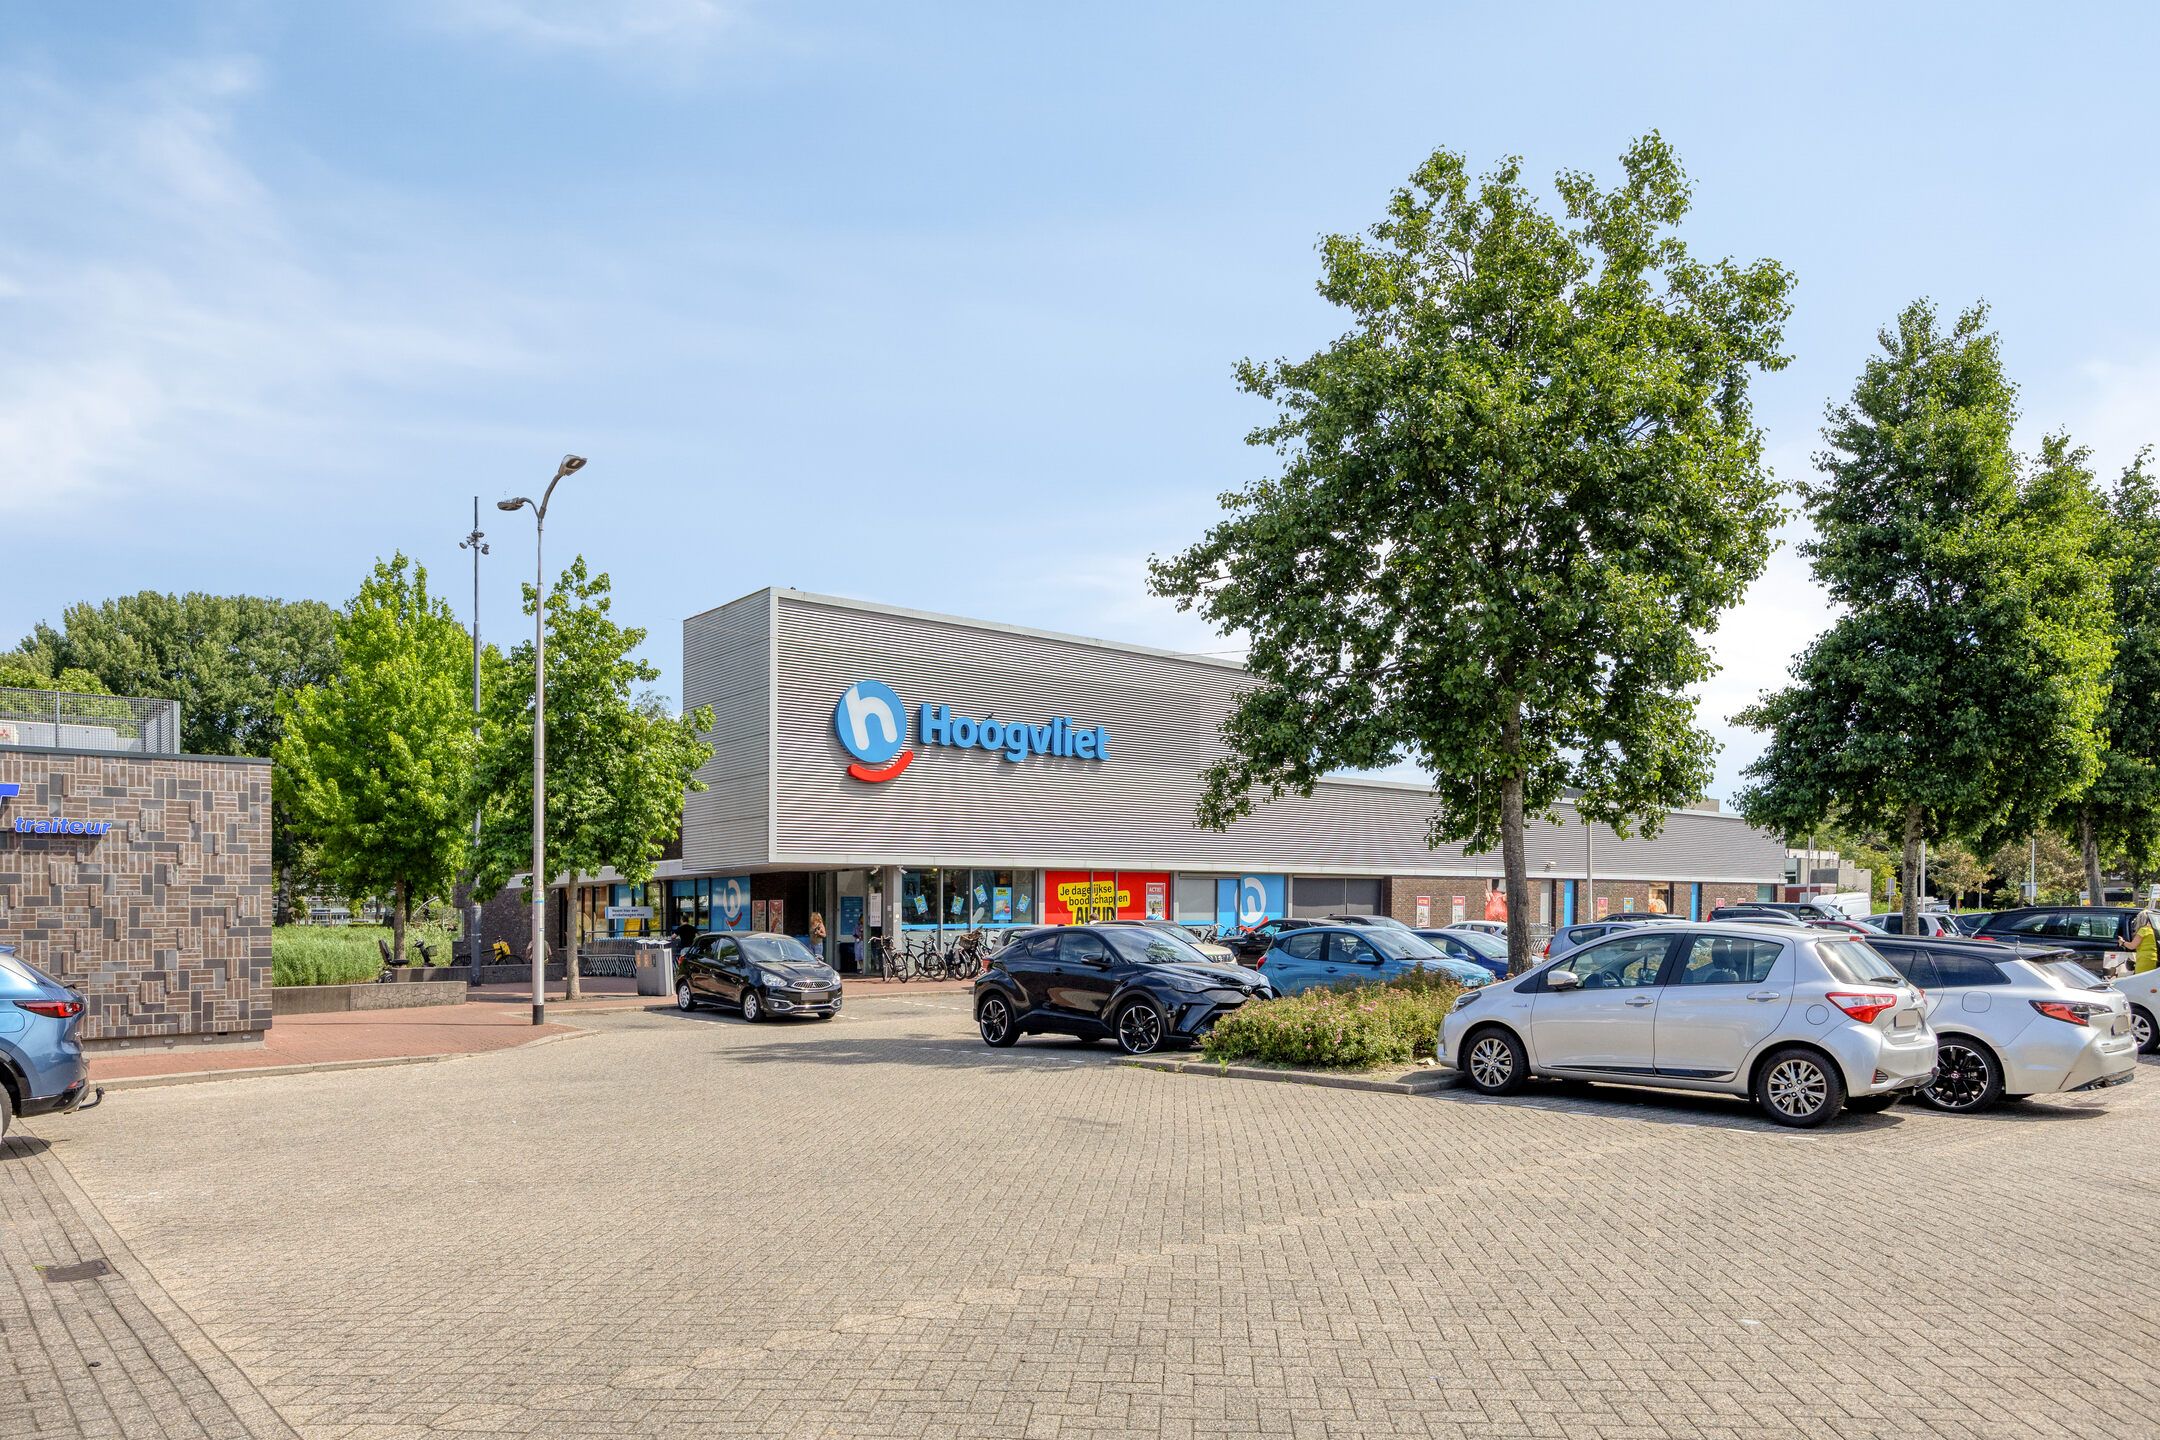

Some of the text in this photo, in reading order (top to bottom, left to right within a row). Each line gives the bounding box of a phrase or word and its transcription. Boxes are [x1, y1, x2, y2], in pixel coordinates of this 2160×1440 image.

[920, 702, 1112, 763] Hoogvliet
[15, 816, 112, 834] traiteur
[1060, 884, 1112, 897] Je dageijkse
[1068, 894, 1128, 906] boodschapen
